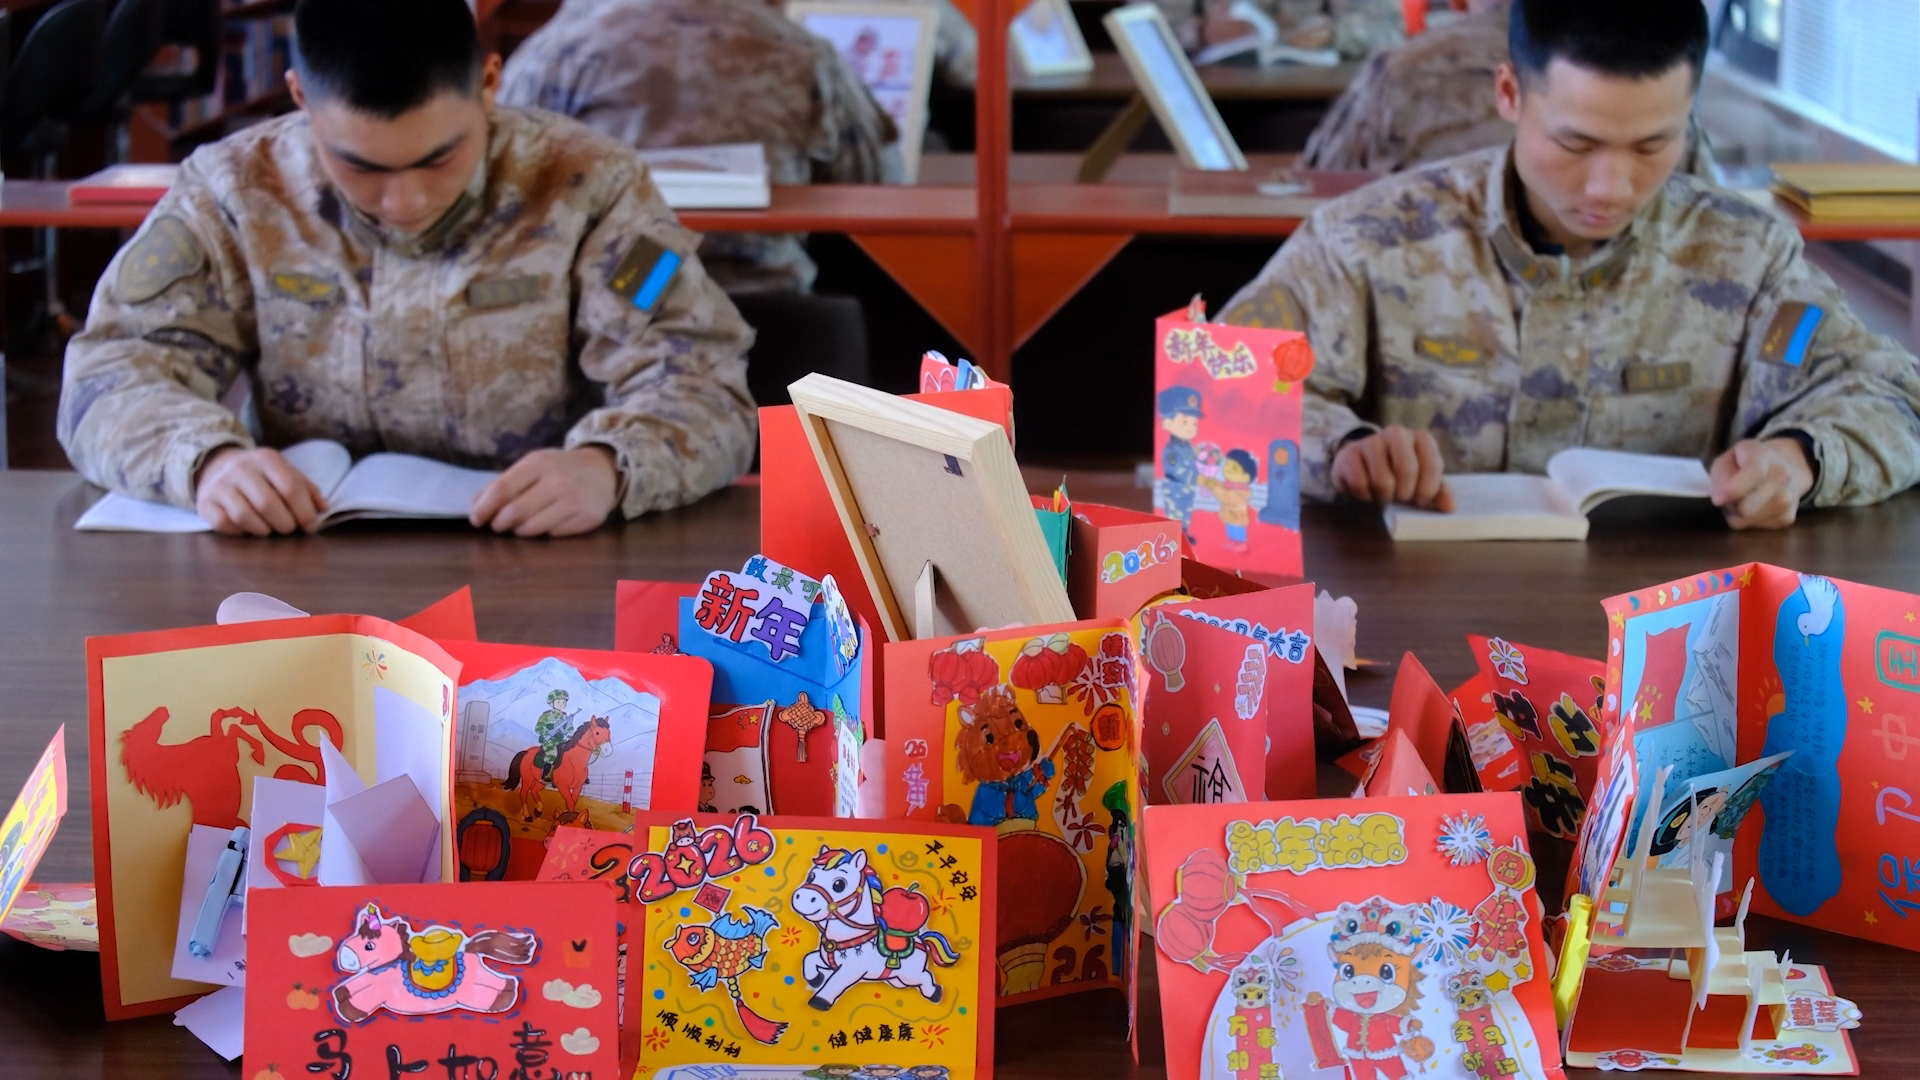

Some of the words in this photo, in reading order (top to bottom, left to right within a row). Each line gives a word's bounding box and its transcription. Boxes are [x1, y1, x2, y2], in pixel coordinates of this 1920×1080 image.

[1166, 330, 1255, 376] 新年快乐
[745, 557, 822, 604] 致最可
[1104, 534, 1171, 583] 2026
[695, 573, 808, 661] 新年
[470, 724, 485, 734] 中国
[629, 815, 773, 902] 2026
[1228, 812, 1407, 875] 新年快乐
[1497, 855, 1519, 881] 福
[925, 838, 980, 902] 早早安安
[305, 1021, 562, 1080] 马上如意
[656, 1009, 742, 1059] 顺顺利利
[827, 1023, 915, 1049] 健健康康
